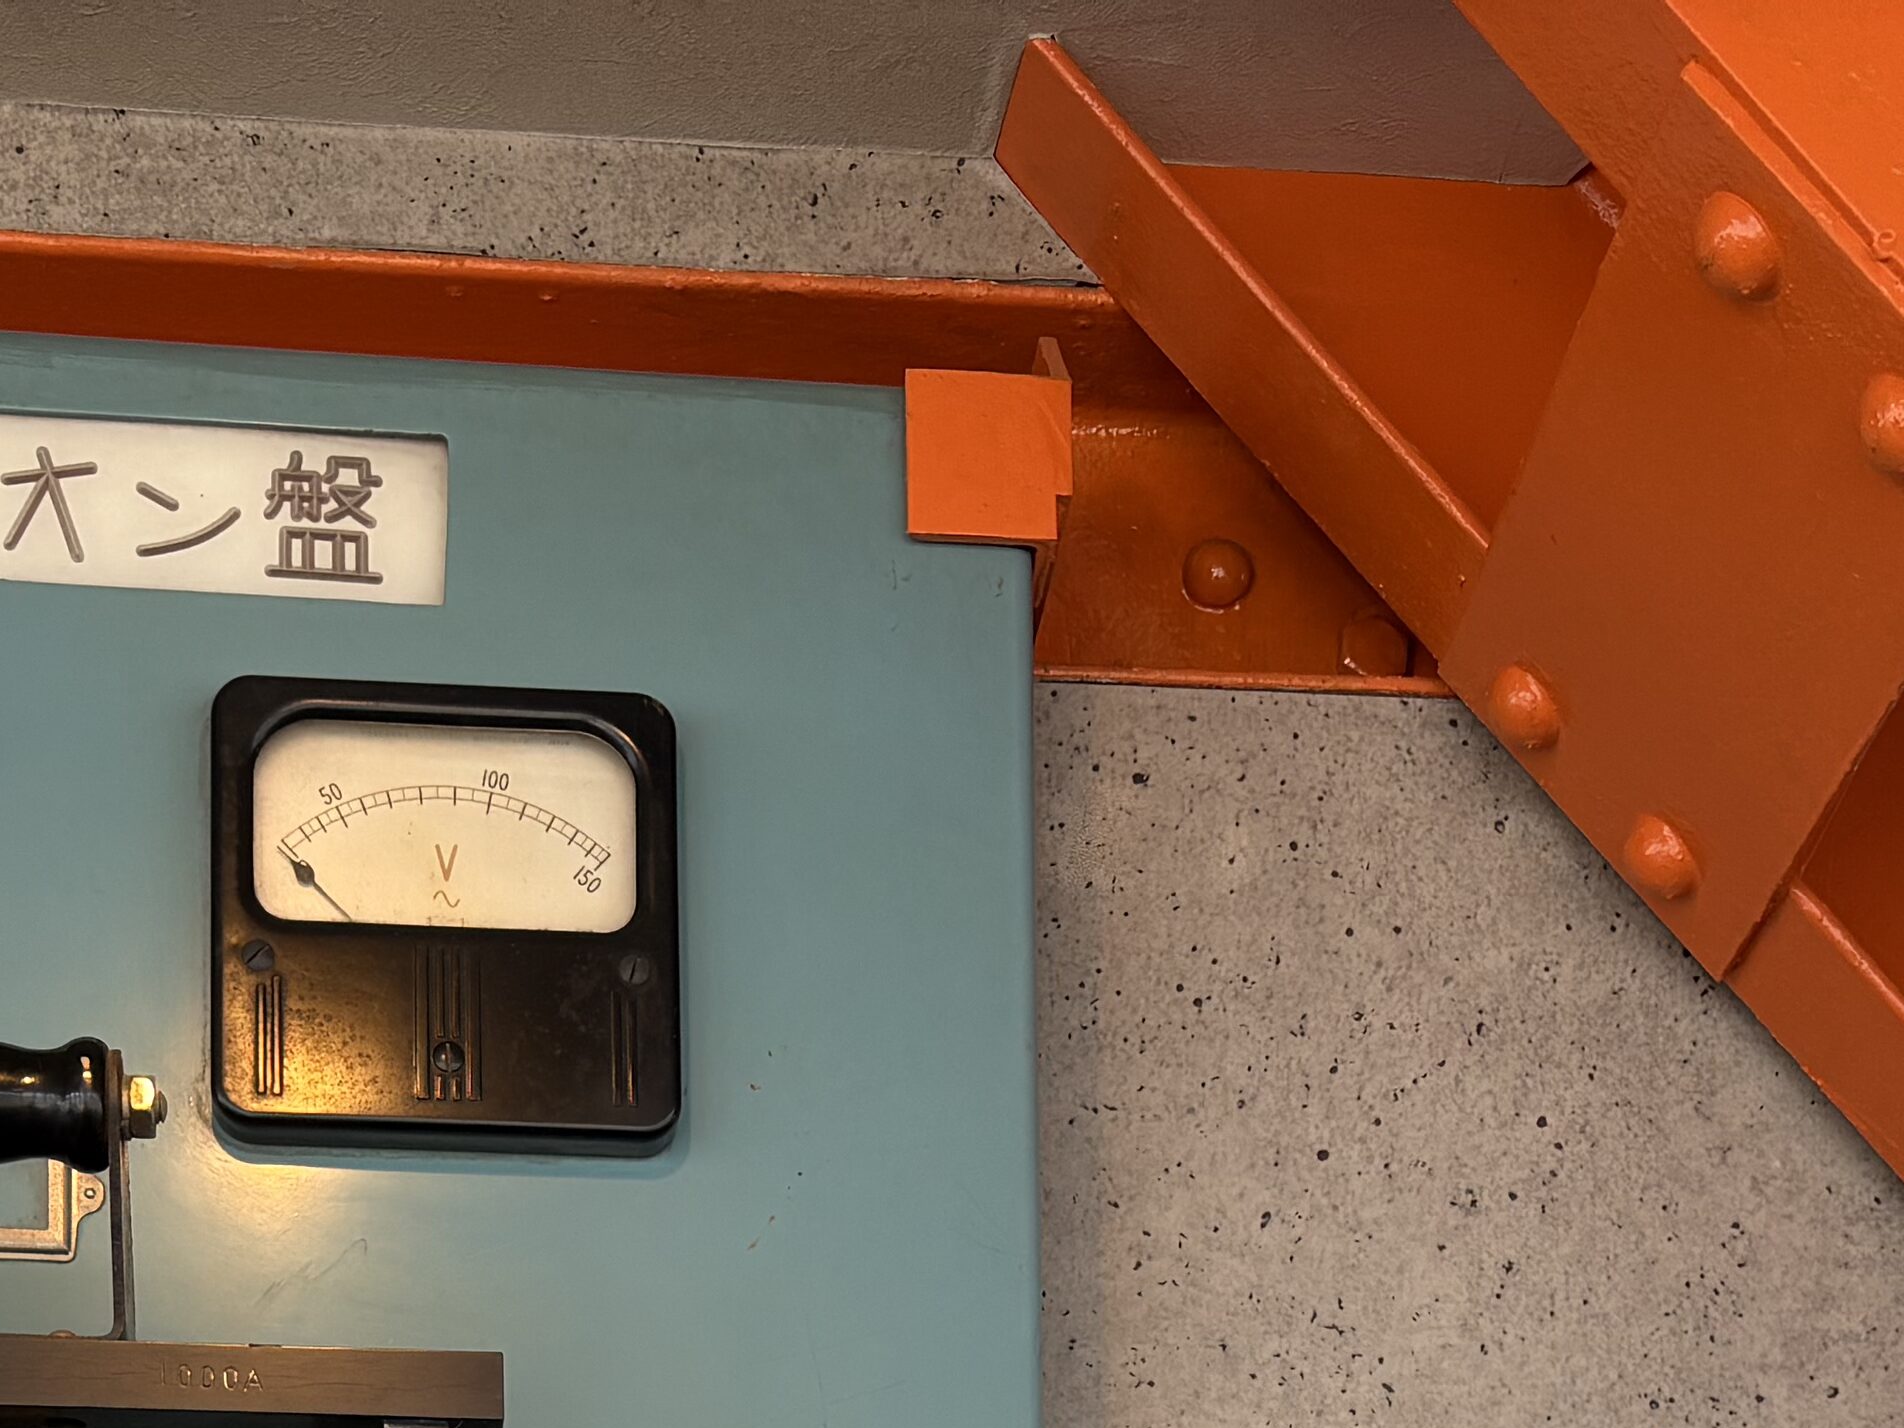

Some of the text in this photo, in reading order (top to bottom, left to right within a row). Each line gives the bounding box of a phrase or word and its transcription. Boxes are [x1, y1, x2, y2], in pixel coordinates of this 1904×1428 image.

[318, 782, 343, 806] 50
[480, 769, 510, 792] 100
[435, 844, 458, 882] V
[572, 864, 603, 895] 150
[160, 1360, 264, 1393] 1000A
